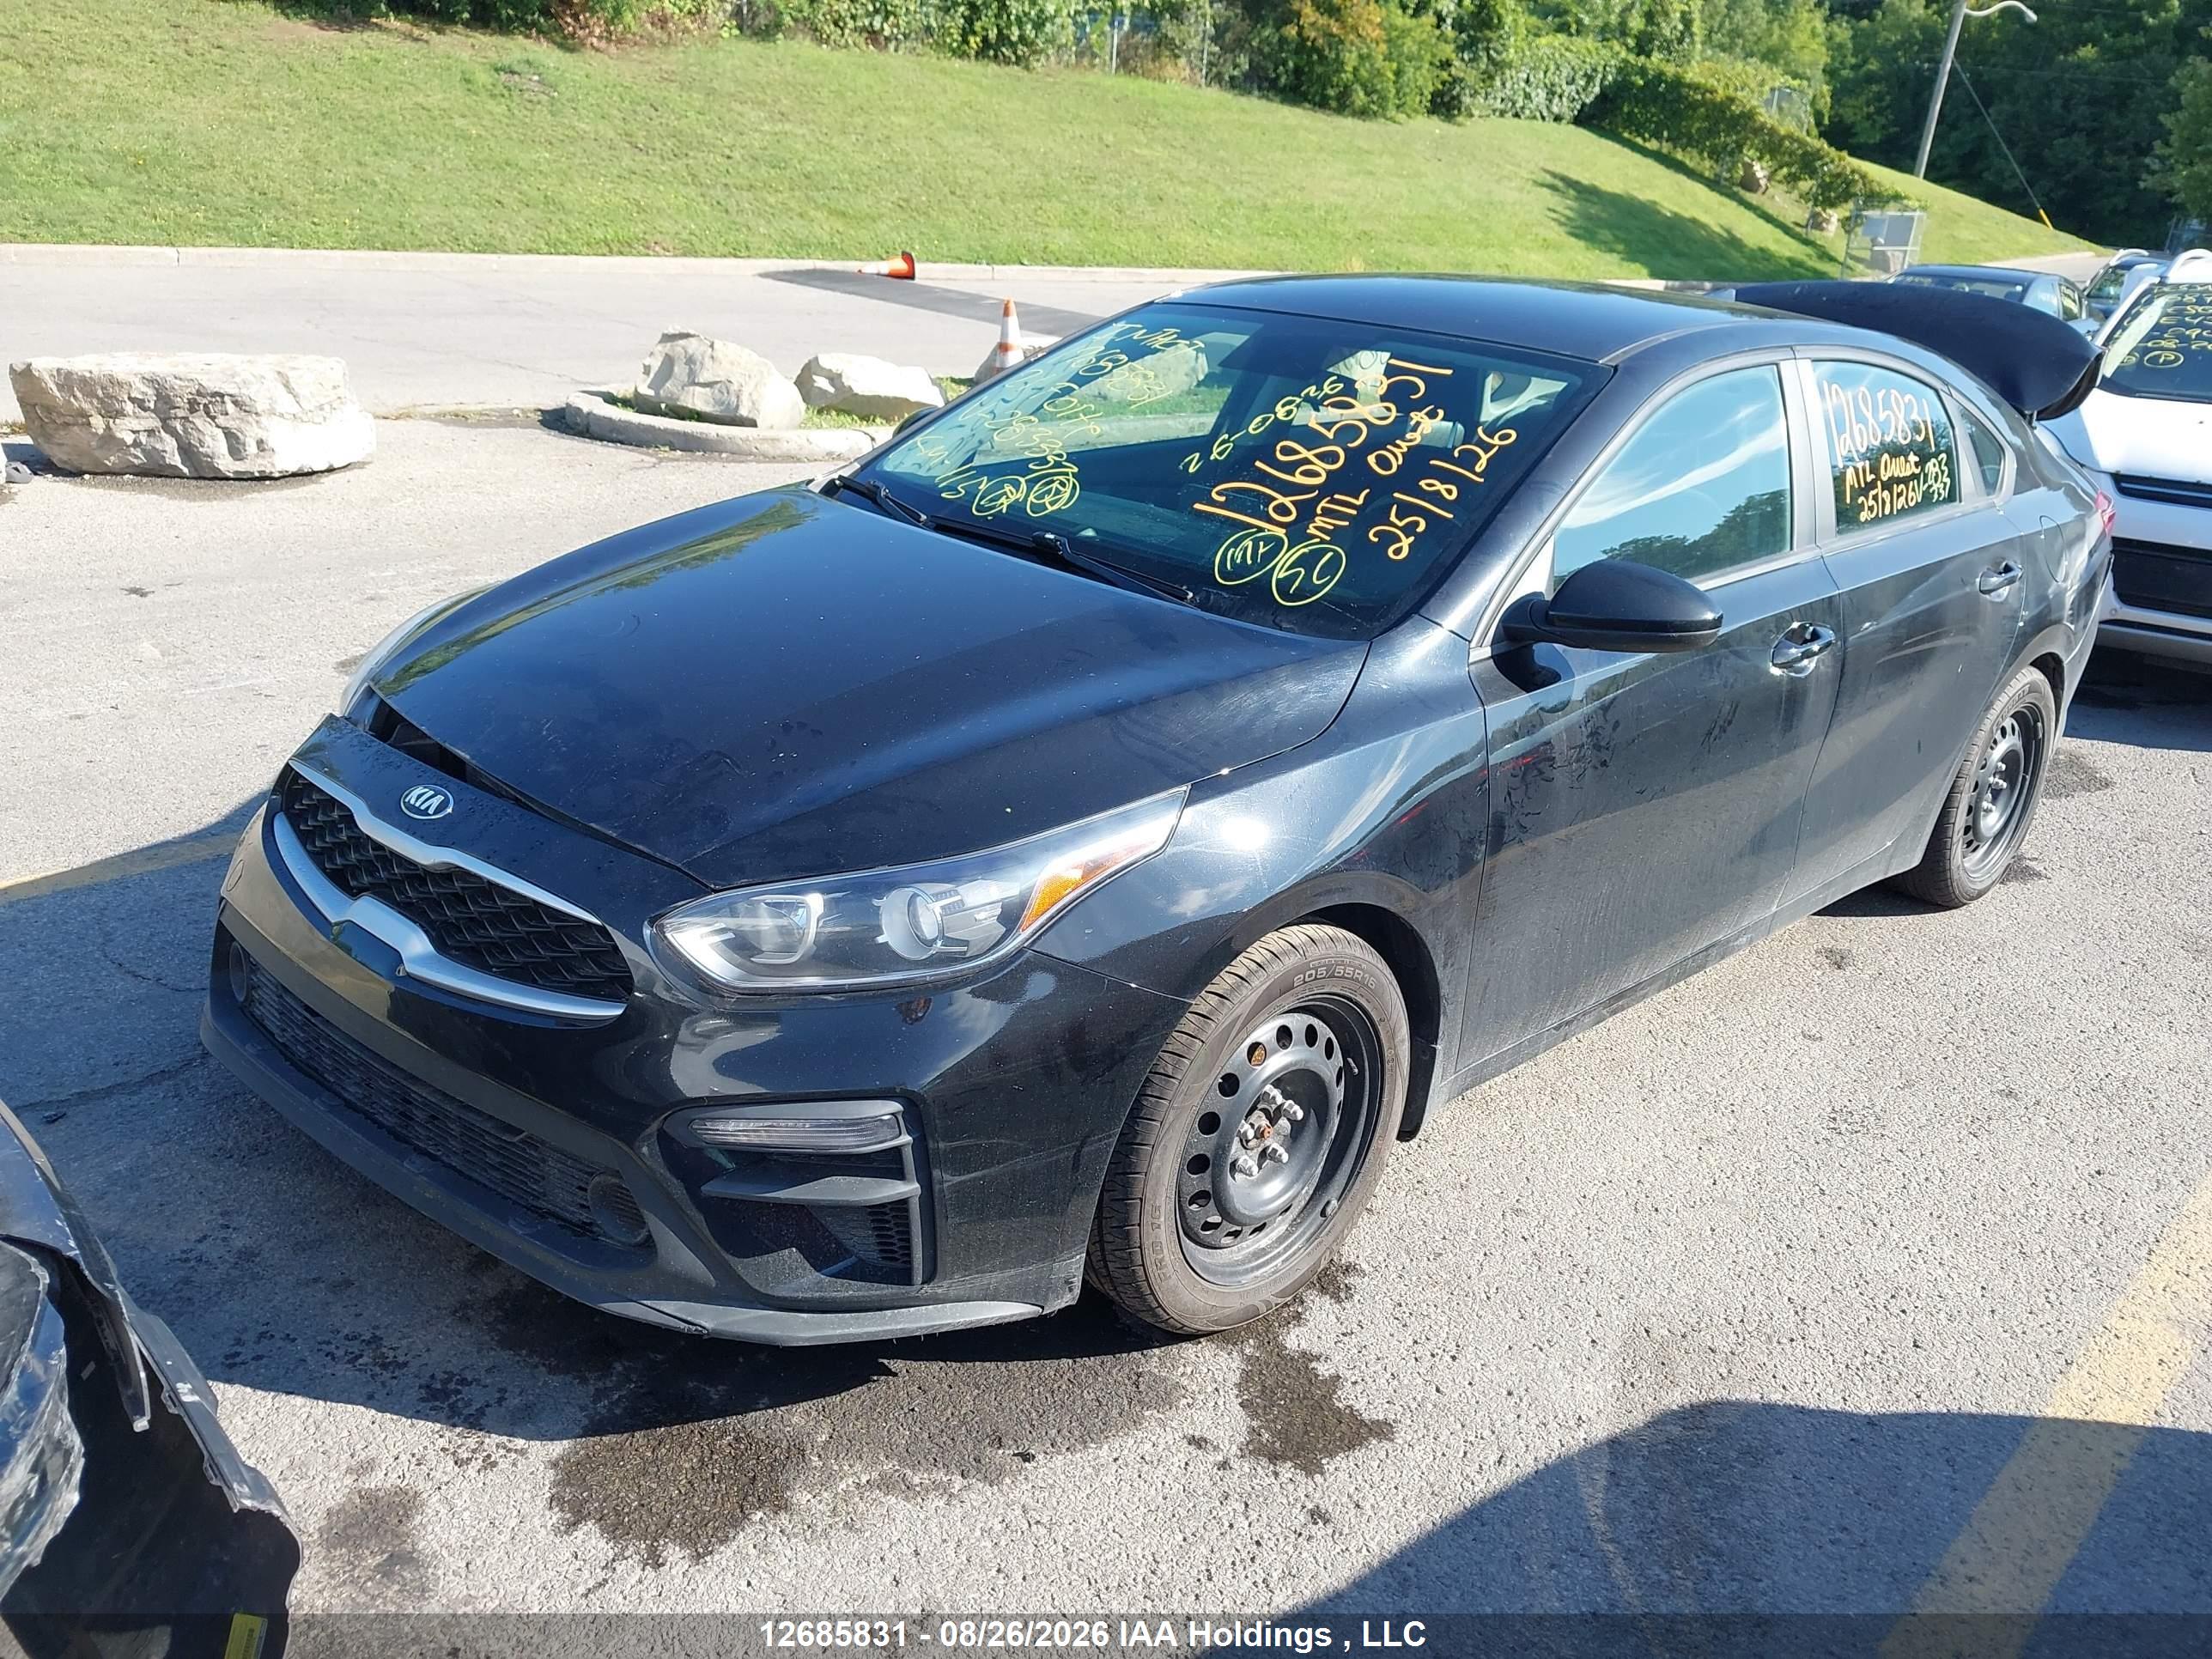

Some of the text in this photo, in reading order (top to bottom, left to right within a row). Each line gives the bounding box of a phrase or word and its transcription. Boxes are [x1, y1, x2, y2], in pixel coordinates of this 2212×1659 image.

[1193, 358, 1455, 534] 12685831
[1823, 380, 1936, 469] 12685831
[404, 786, 445, 815] KIA
[1293, 964, 1377, 990] 205/55R16
